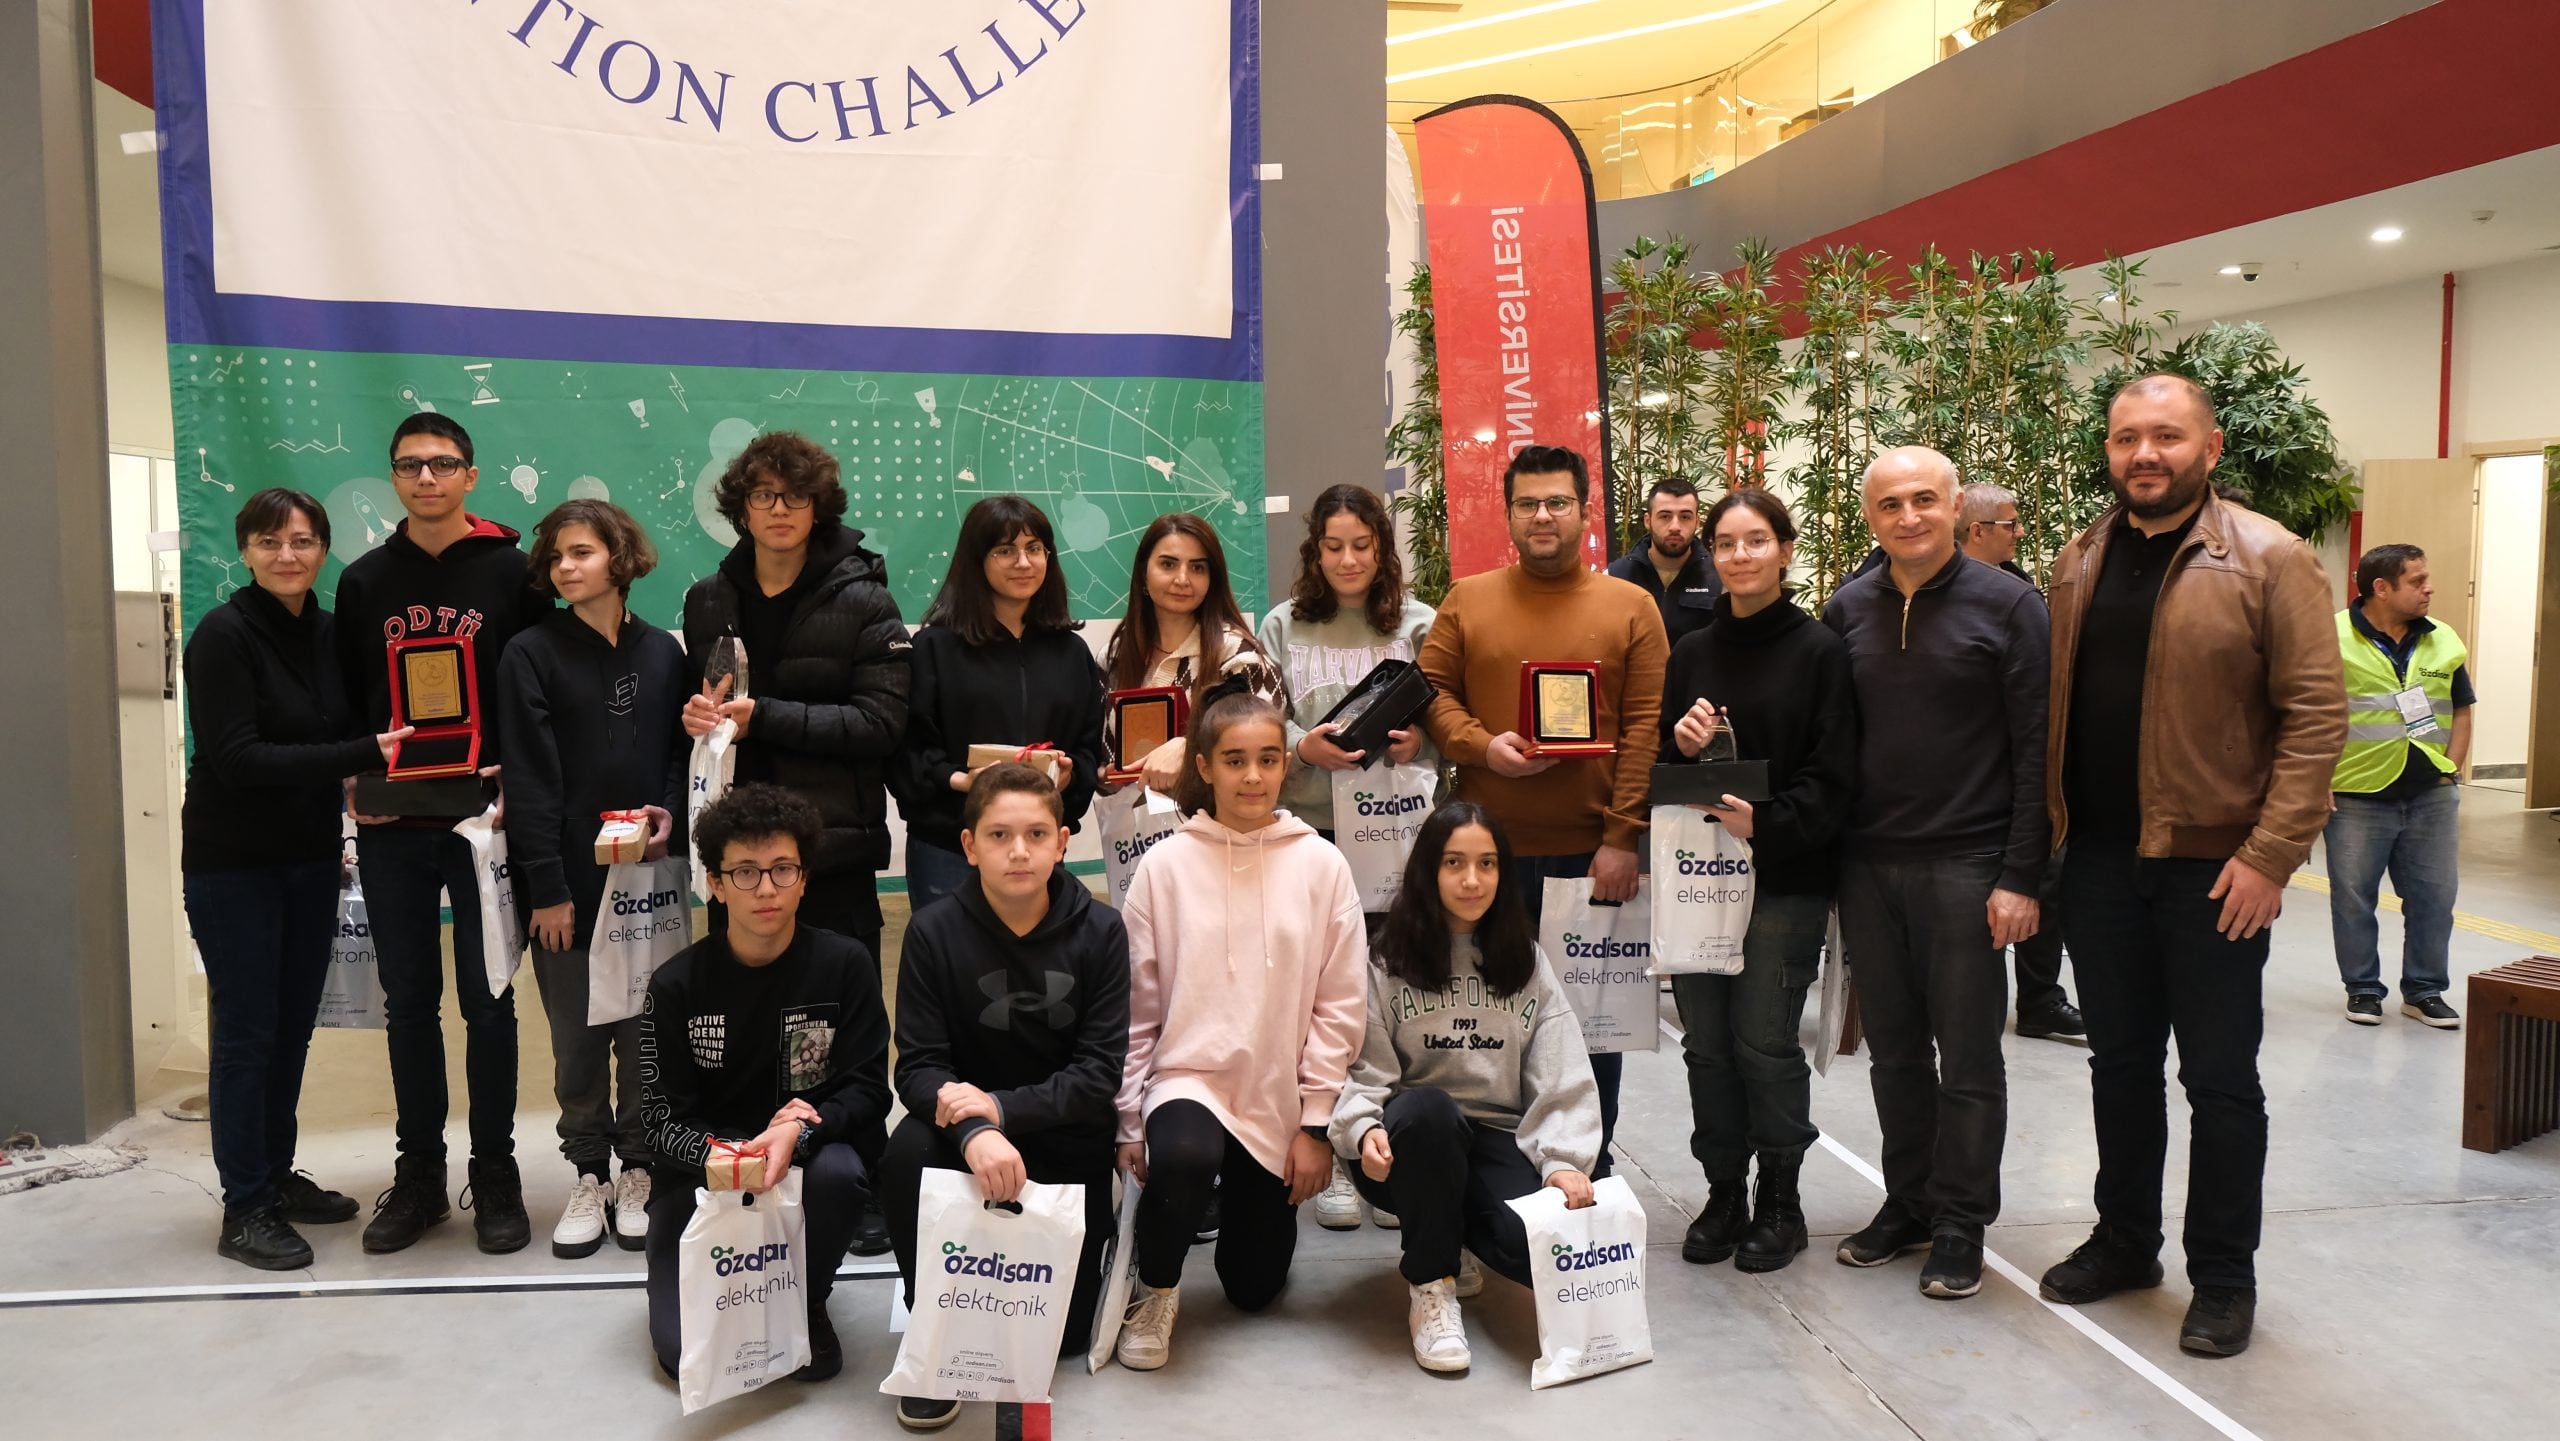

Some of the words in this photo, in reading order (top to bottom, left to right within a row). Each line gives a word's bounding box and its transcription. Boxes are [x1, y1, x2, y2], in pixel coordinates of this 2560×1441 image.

[471, 0, 735, 132] TION
[384, 604, 483, 641] ODTÜ
[1675, 849, 1749, 876] özdisa
[1677, 885, 1747, 904] elektro
[1563, 966, 1650, 985] elektronik
[1389, 975, 1538, 1032] CALIFORNA
[784, 1020, 828, 1032] SPORTSWEAR
[1452, 1018, 1477, 1031] 1993
[1423, 1033, 1465, 1050] United
[1468, 1033, 1504, 1050] States
[942, 1241, 1053, 1284] özdisan
[1557, 1270, 1641, 1303] elektronik
[938, 1286, 1047, 1317] elektronik
